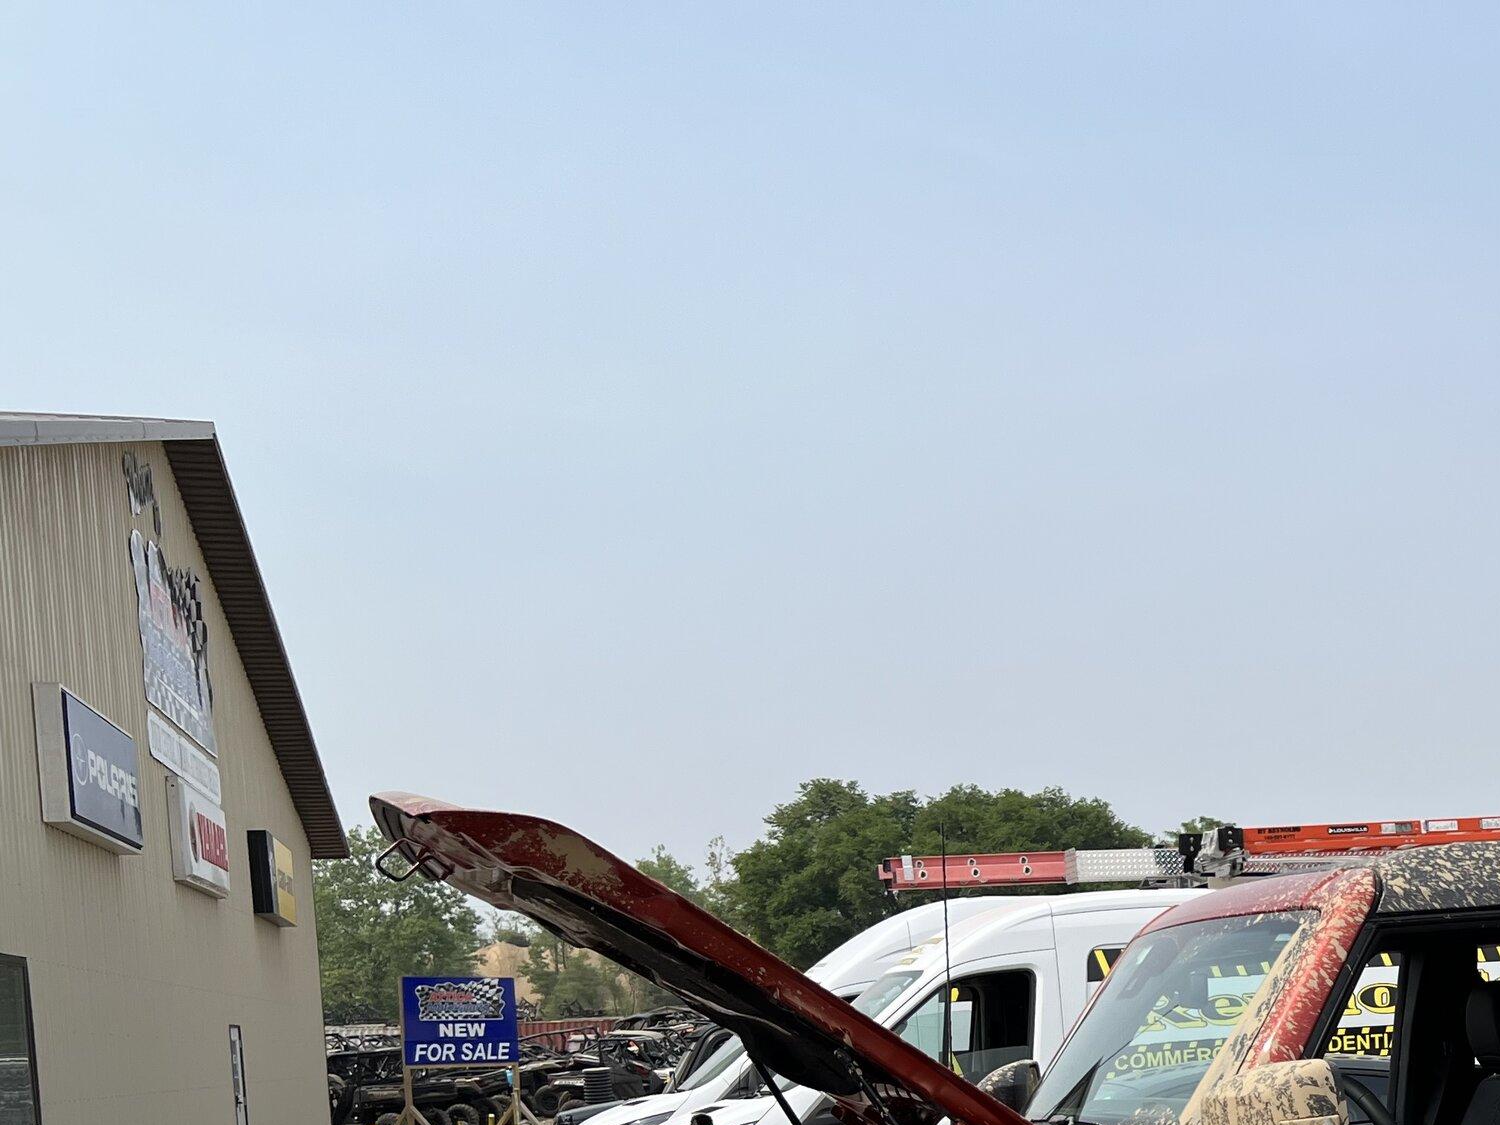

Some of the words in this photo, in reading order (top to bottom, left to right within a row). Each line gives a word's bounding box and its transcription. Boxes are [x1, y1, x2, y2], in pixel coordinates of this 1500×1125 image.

[438, 1023, 486, 1038] NEW
[415, 1044, 456, 1062] FOR
[461, 1042, 510, 1060] SALE
